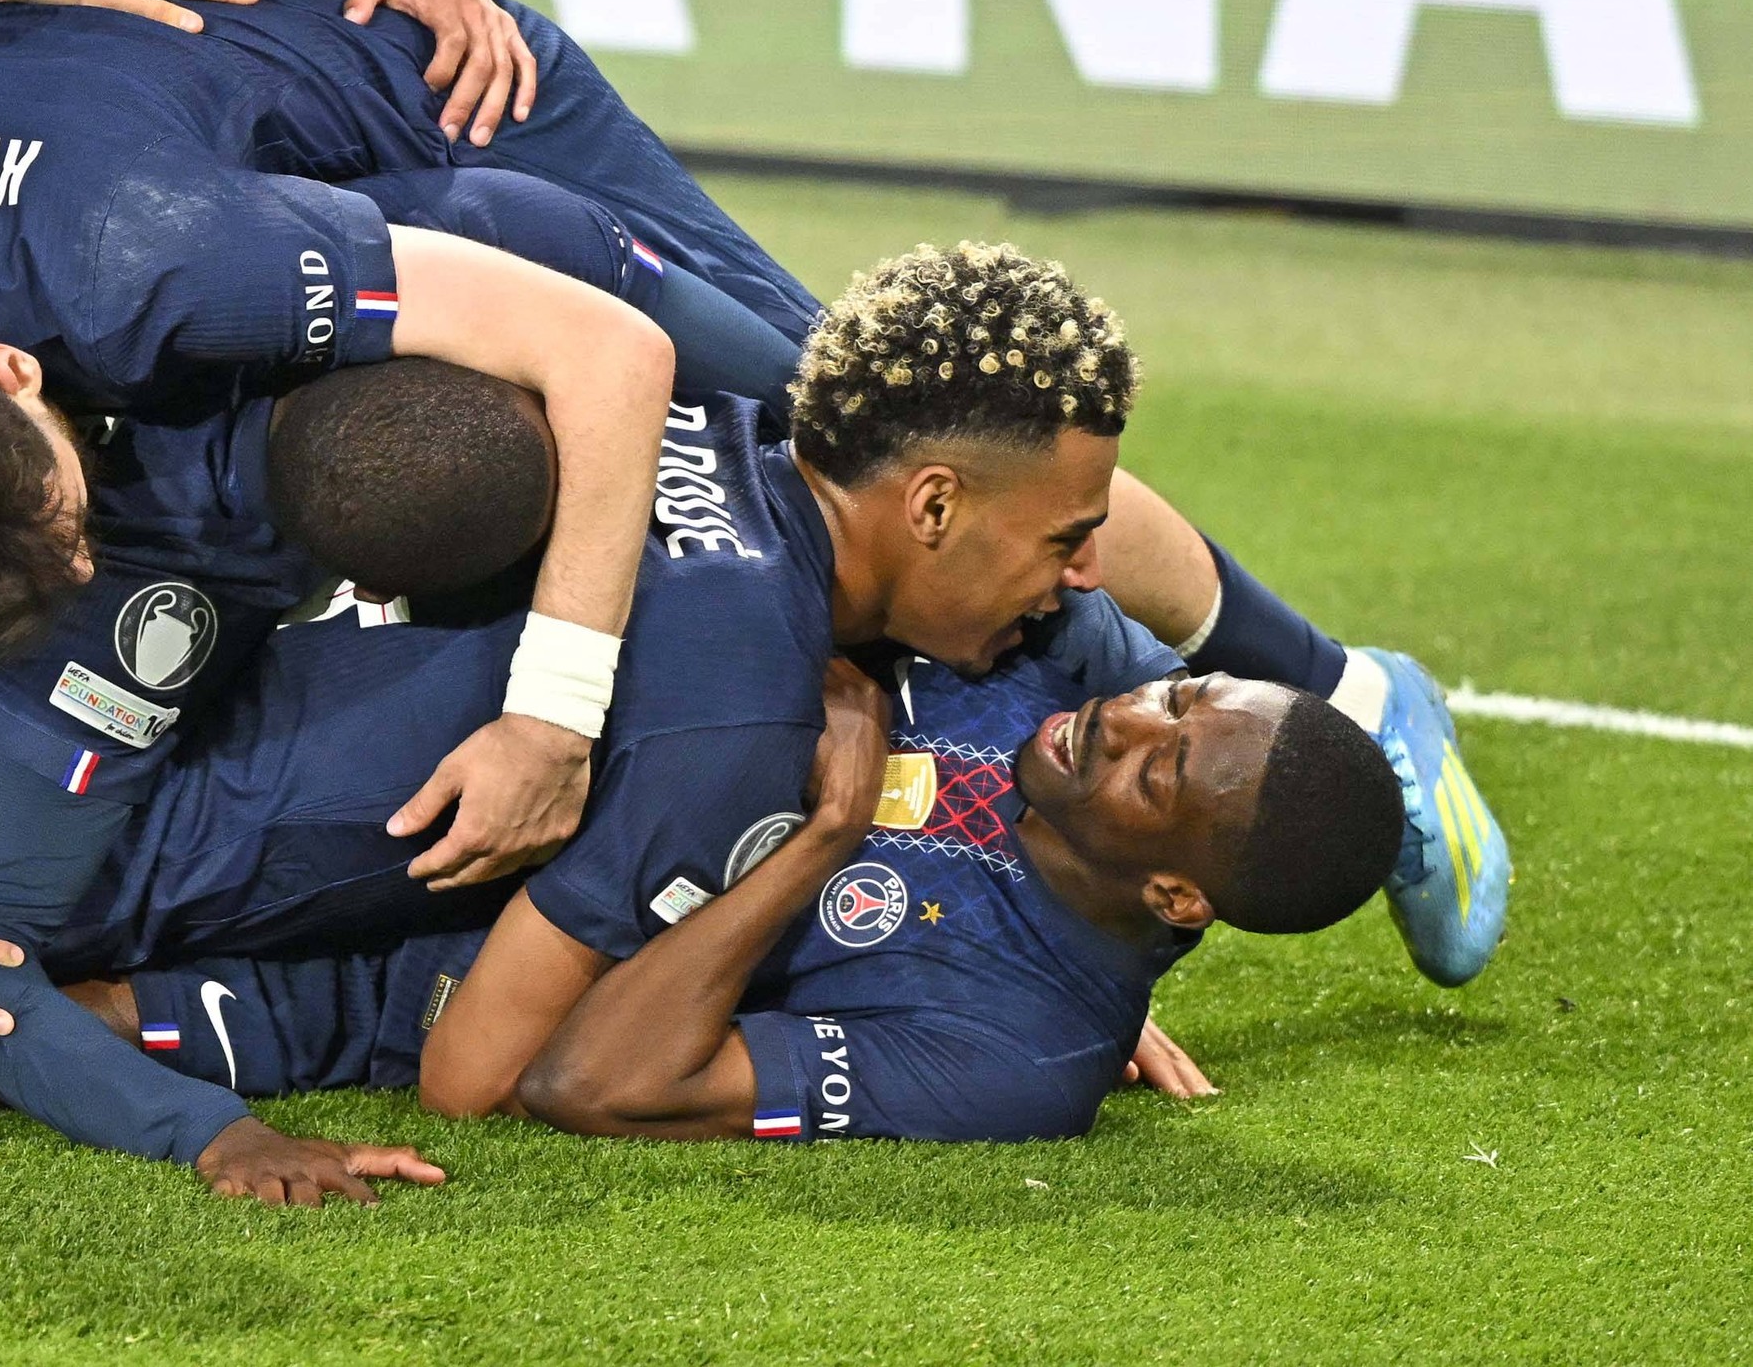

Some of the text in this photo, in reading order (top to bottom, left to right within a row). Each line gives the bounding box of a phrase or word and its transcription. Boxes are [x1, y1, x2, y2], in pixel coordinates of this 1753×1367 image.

[299, 249, 335, 363] OND
[68, 665, 91, 683] UEFA
[59, 678, 144, 730] FOUNDATION
[826, 901, 842, 932] GERMAIN
[884, 877, 903, 932] PARIS
[805, 1015, 851, 1135] EYON
